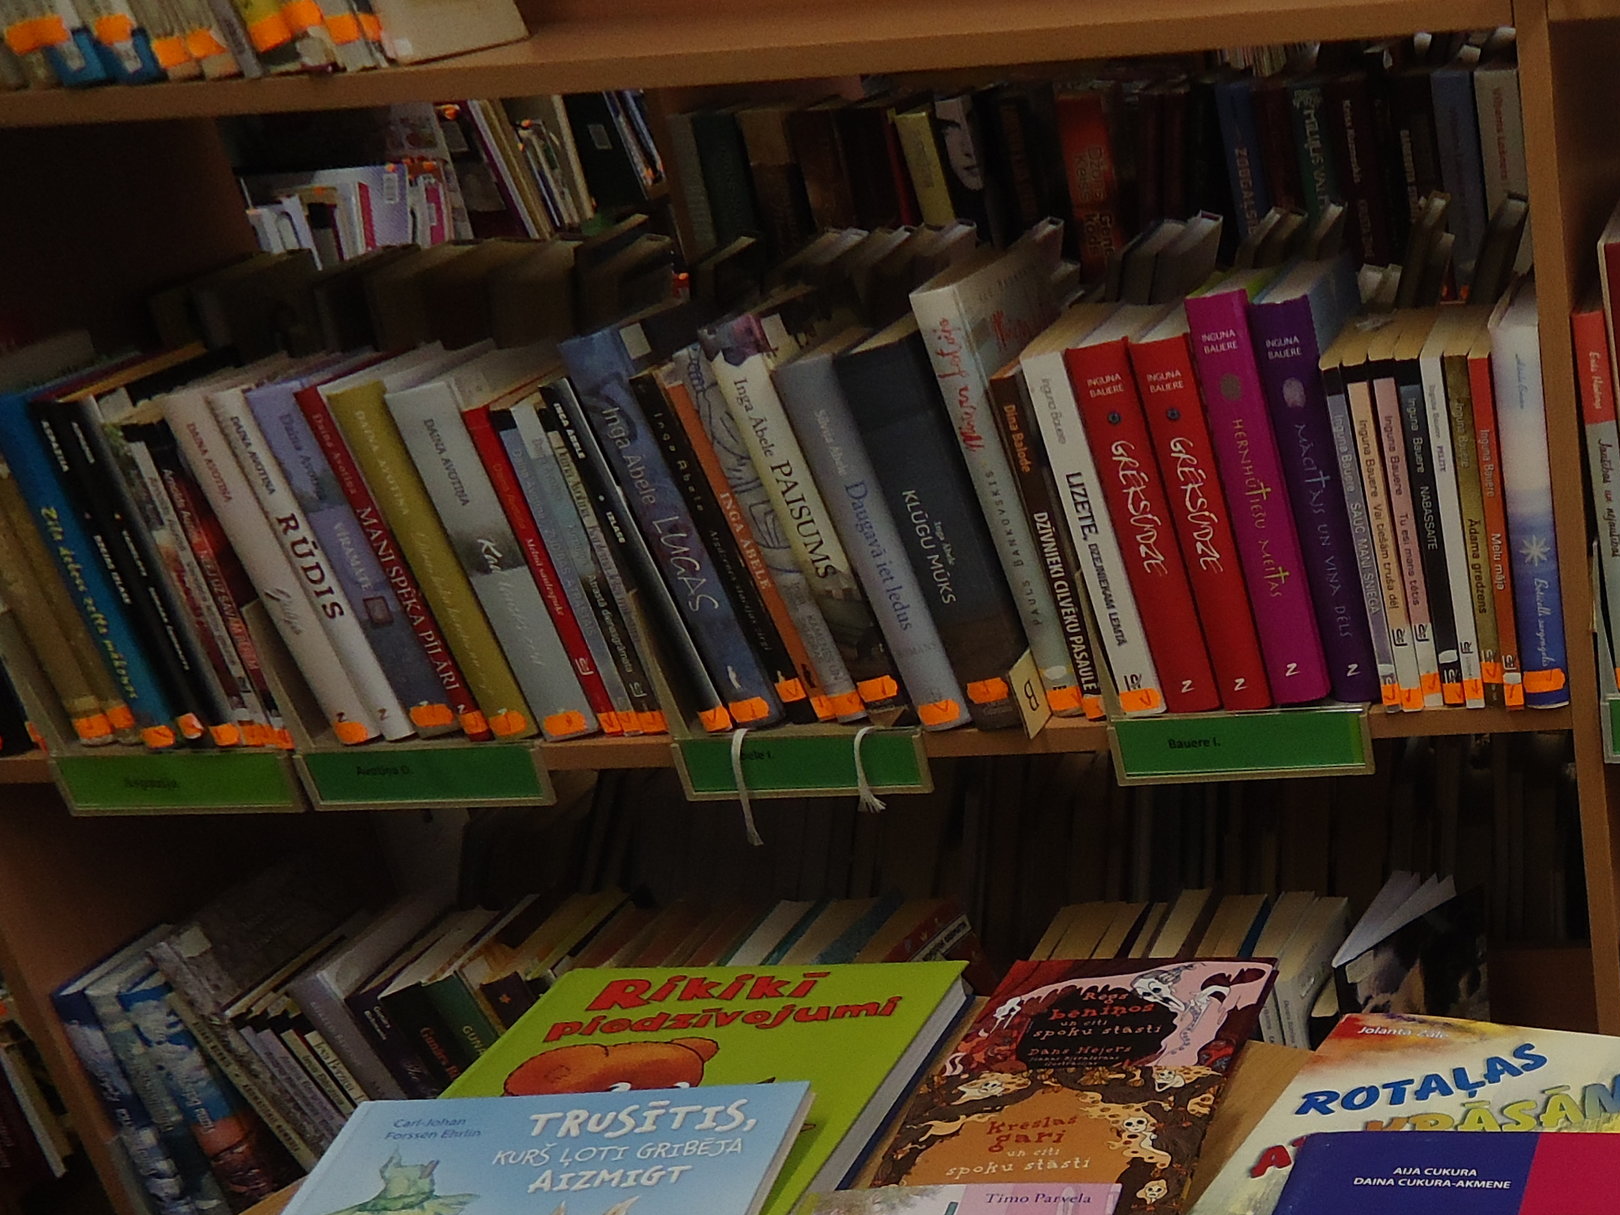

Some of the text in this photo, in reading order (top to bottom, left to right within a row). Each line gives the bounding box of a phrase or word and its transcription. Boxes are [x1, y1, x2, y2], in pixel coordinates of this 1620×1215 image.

[1201, 329, 1236, 342] INGUNA
[1203, 340, 1238, 354] BAUERE
[1265, 336, 1300, 348] INGUNA
[1267, 347, 1302, 360] BAUERE
[1087, 373, 1121, 387] INGUNA
[1147, 370, 1182, 382] INGUNA
[1149, 381, 1184, 393] BAUERE
[1090, 384, 1124, 398] BAUERE
[601, 406, 632, 449] Inga
[734, 378, 754, 413] Inga
[771, 460, 837, 579] PAISUMS
[1066, 472, 1098, 541] LIZETE,
[356, 507, 389, 563] MANI
[902, 490, 956, 604] KLŪGU MŪKS
[277, 513, 344, 619] RŪDIS
[844, 480, 884, 561] Daugavā
[888, 586, 912, 631] ledus
[1033, 511, 1097, 691] DZĪVNIEKI CILVĒKU PASAULE
[1471, 562, 1486, 614] gredzens
[543, 995, 905, 1043] piedzīvojumi
[1358, 1025, 1412, 1038] Jolanta
[1294, 1042, 1548, 1116] ROTAĻAS
[529, 1101, 758, 1138] TRUSĪTIS,
[492, 1138, 743, 1167] KURŠ ĻOTI GRIBĒJA
[527, 1164, 692, 1194] AIZMIGT
[946, 1161, 1014, 1179] spoku
[1353, 1177, 1512, 1189] DAINA CUKURA-AKMENE
[1393, 1167, 1478, 1176] AIJA CUKURA
[986, 1193, 1091, 1204] Timo Parvela
